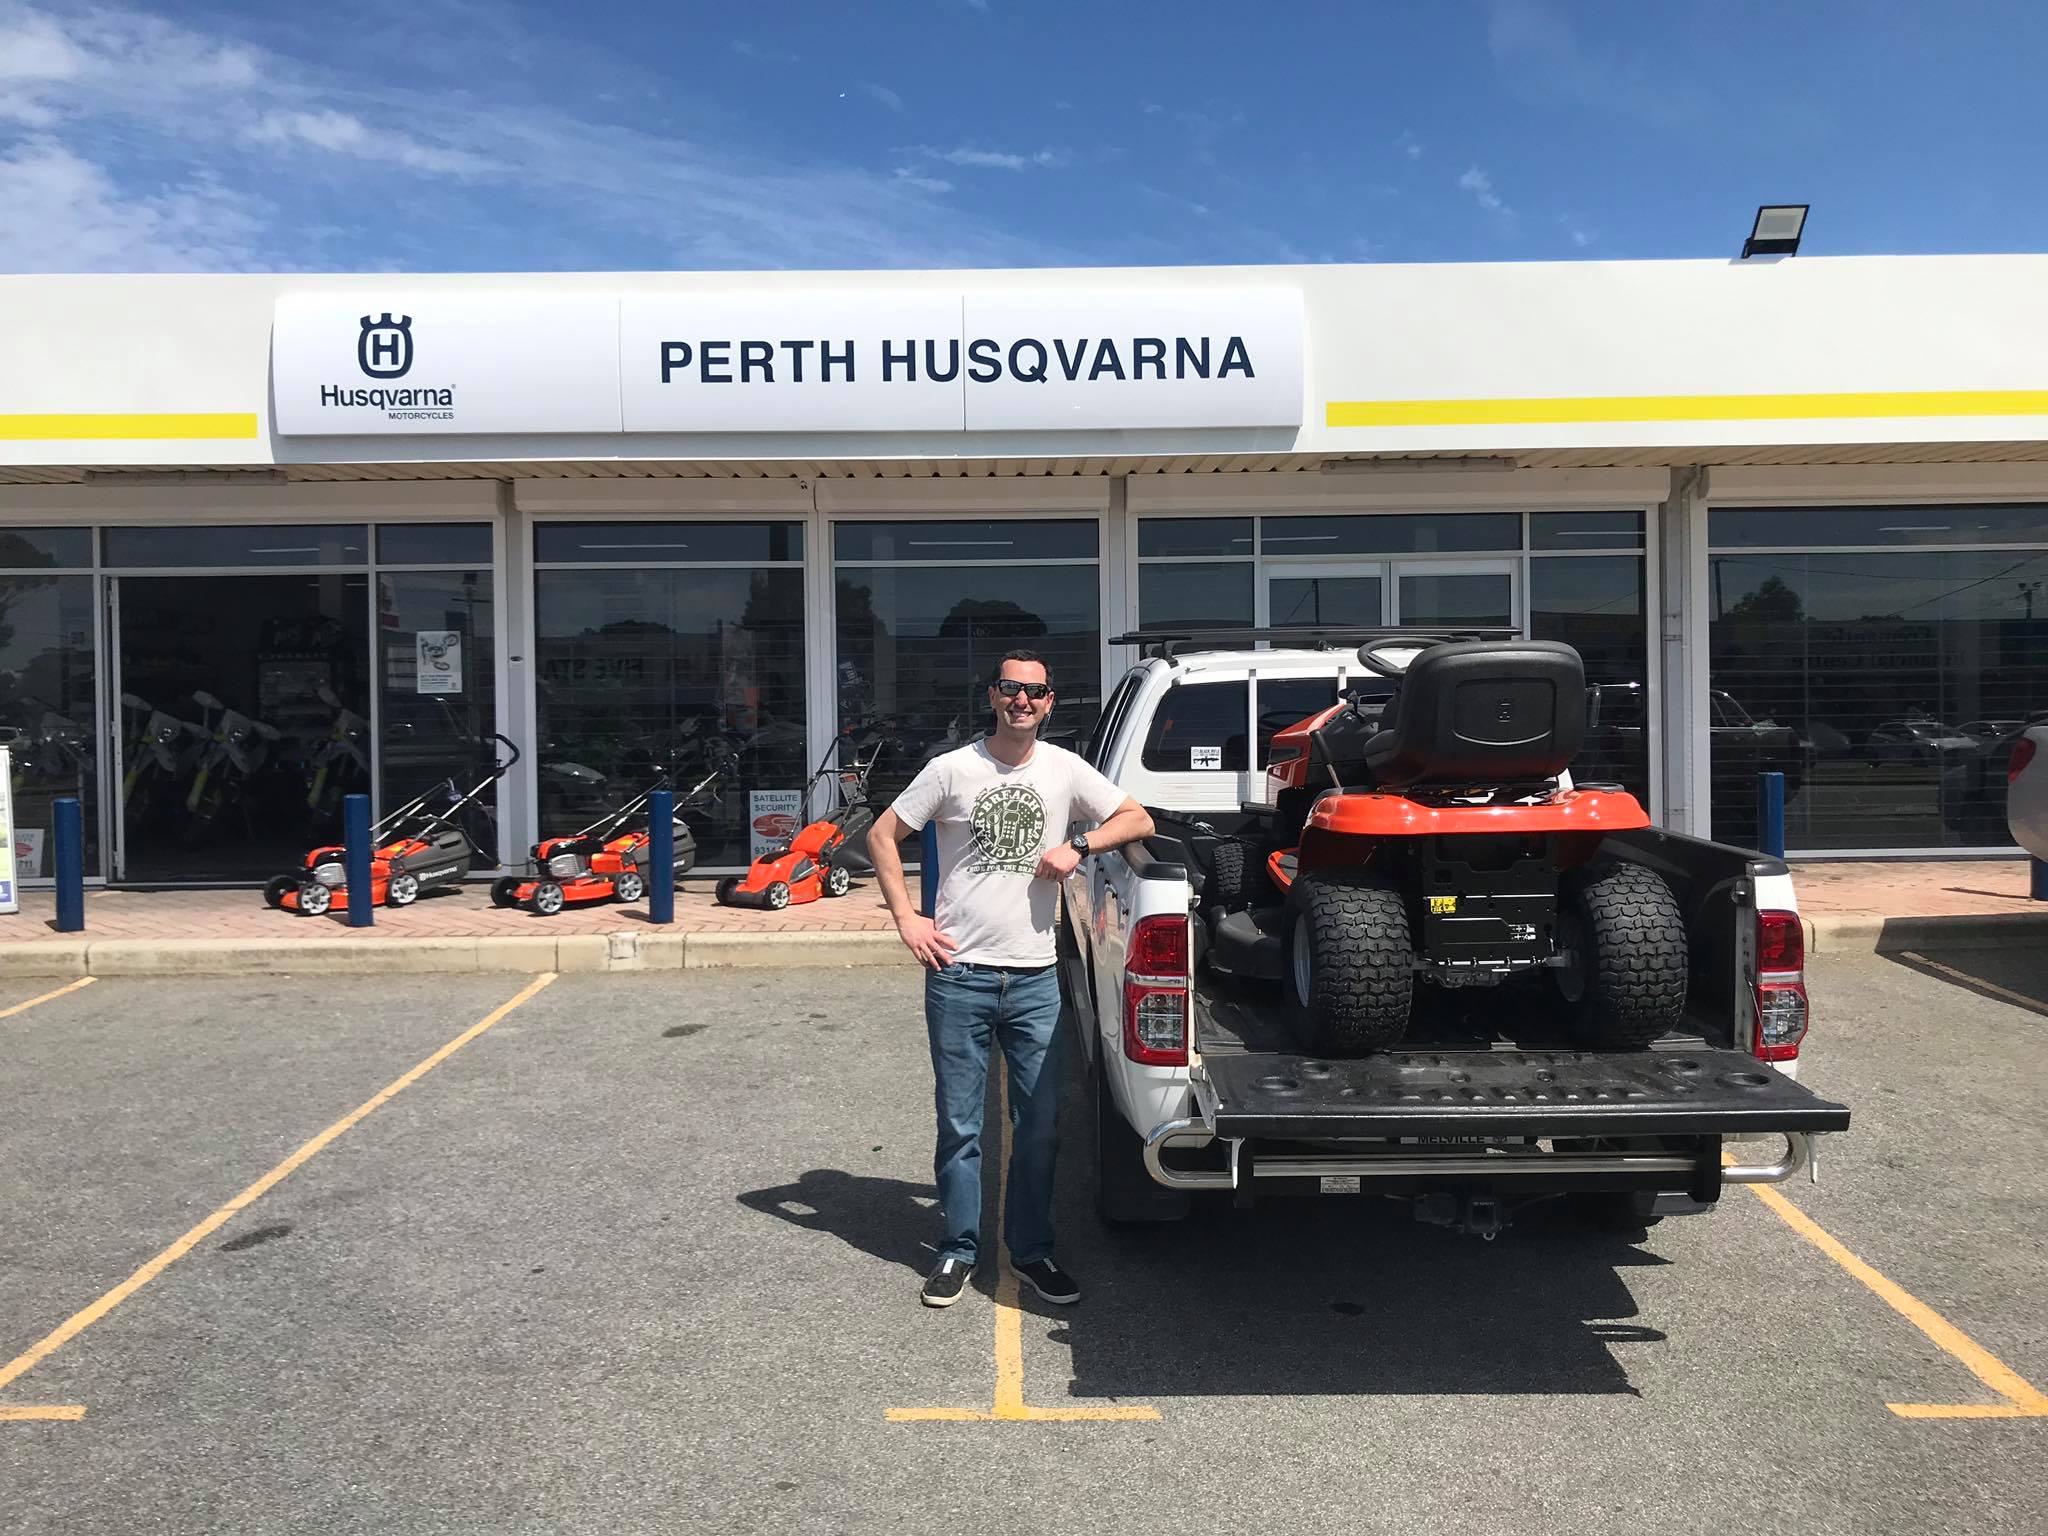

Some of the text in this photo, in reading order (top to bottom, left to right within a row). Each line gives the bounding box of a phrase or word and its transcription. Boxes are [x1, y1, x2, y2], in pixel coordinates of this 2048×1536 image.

[661, 336, 1256, 384] PERTH HUSQVARNA
[320, 384, 453, 411] Husqvarna
[388, 412, 455, 420] MOTORCYCLES
[753, 794, 798, 802] SATELLITE
[754, 804, 797, 812] SECURITY
[974, 789, 1043, 858] BREACH BANG CLEAR
